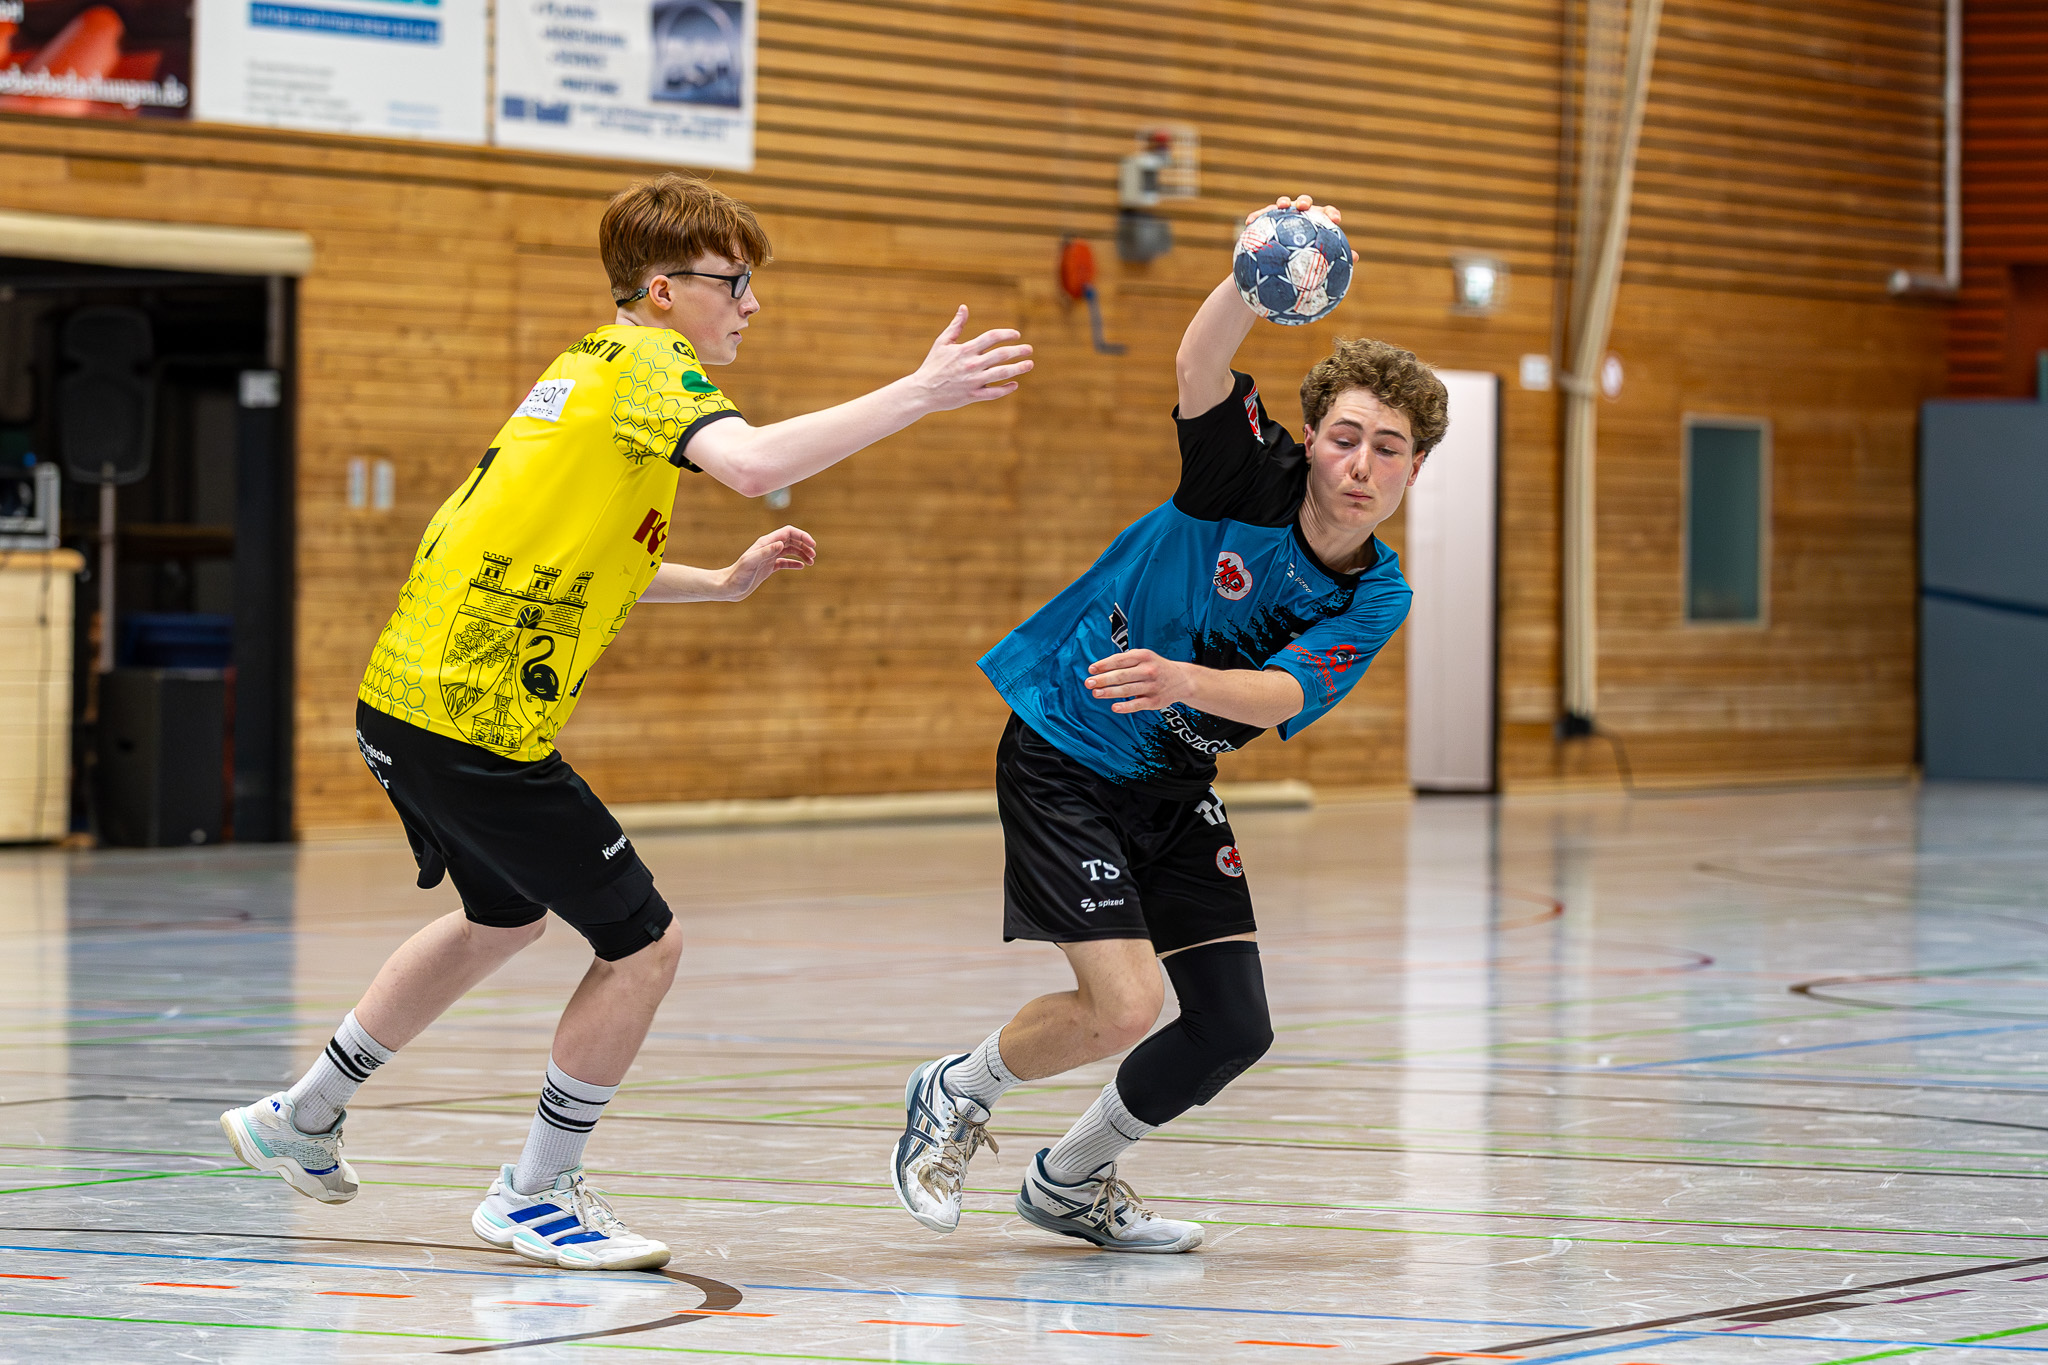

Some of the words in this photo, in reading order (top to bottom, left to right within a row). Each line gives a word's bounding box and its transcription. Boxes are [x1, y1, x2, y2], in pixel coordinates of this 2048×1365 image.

[598, 341, 627, 363] TV
[1082, 859, 1121, 881] TS
[1098, 898, 1125, 908] spized
[545, 1086, 570, 1105] NIKE
